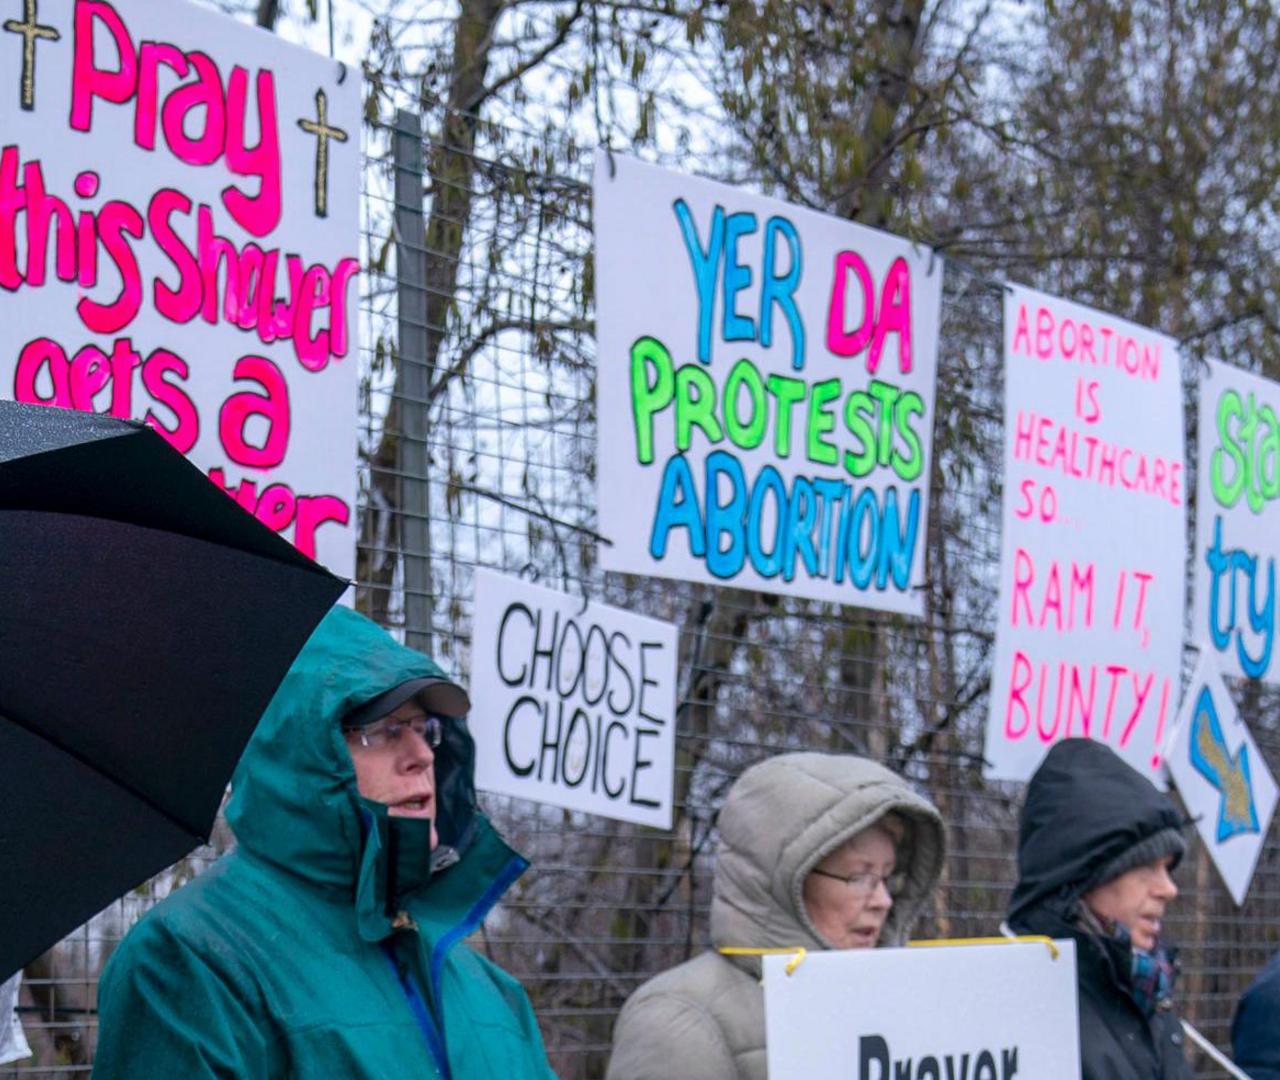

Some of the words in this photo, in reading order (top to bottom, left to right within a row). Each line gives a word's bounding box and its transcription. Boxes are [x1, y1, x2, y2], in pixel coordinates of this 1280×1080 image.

[70, 0, 283, 238] Pray
[673, 197, 806, 370] YER
[825, 249, 913, 374] DA
[1012, 302, 1161, 382] ABORTION
[220, 355, 290, 469] a
[629, 335, 925, 482] PROTESTS
[1015, 409, 1181, 505] HEALTHCARE
[1075, 376, 1101, 425] IS
[649, 449, 922, 591] ABORTION
[1011, 548, 1095, 632] RAM
[1112, 570, 1154, 650] IT,
[1206, 514, 1276, 680] try
[496, 601, 666, 725] CHOOSE
[1005, 650, 1171, 770] BUNTY!
[502, 695, 661, 810] CHOICE
